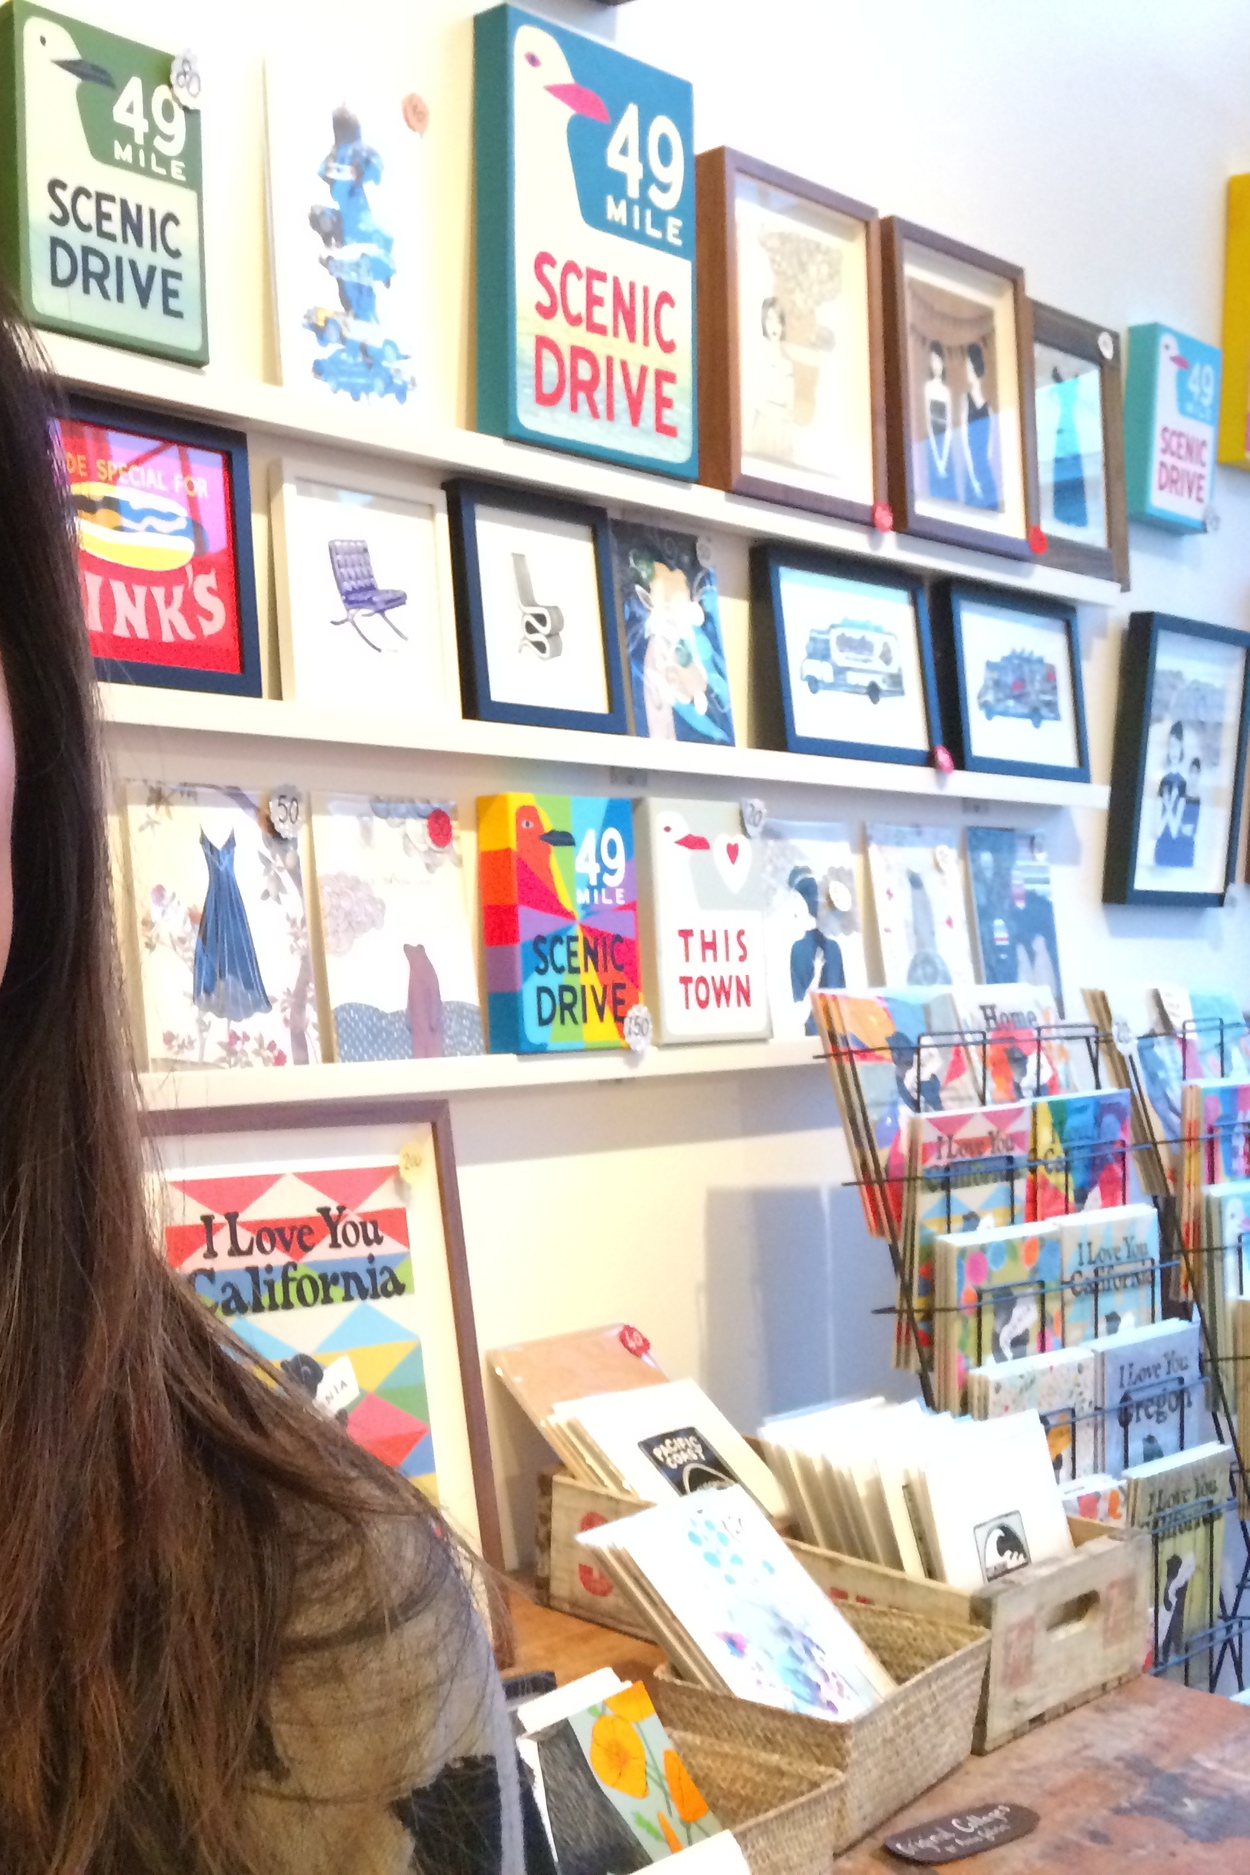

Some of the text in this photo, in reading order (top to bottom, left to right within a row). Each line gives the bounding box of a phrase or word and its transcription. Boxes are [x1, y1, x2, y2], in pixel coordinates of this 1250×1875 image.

[112, 76, 187, 157] 49
[114, 144, 187, 182] MILE
[606, 102, 685, 210] 49
[47, 177, 183, 260] SCENIC
[606, 194, 683, 246] MILE
[50, 235, 185, 320] DRIVE
[533, 250, 677, 355] SCENIC
[533, 334, 679, 439] DRIVE
[1188, 362, 1214, 406] 49
[1161, 426, 1208, 468] SCENIC
[96, 458, 168, 491] SPECIAL
[174, 473, 209, 498] FOR
[1158, 460, 1205, 504] DRIVE
[277, 794, 300, 823] 50
[575, 827, 626, 888] 49
[576, 887, 626, 905] MILE
[532, 933, 625, 976] SCENIC
[677, 929, 748, 963] THIS
[536, 982, 627, 1028] DRIVE
[679, 974, 751, 1010] TOWN
[979, 1004, 1039, 1032] Home
[200, 1205, 384, 1259] I Love You
[189, 1253, 406, 1316] California
[1119, 1365, 1125, 1388] I
[1163, 1350, 1189, 1375] You
[653, 1436, 701, 1462] PACIFIC
